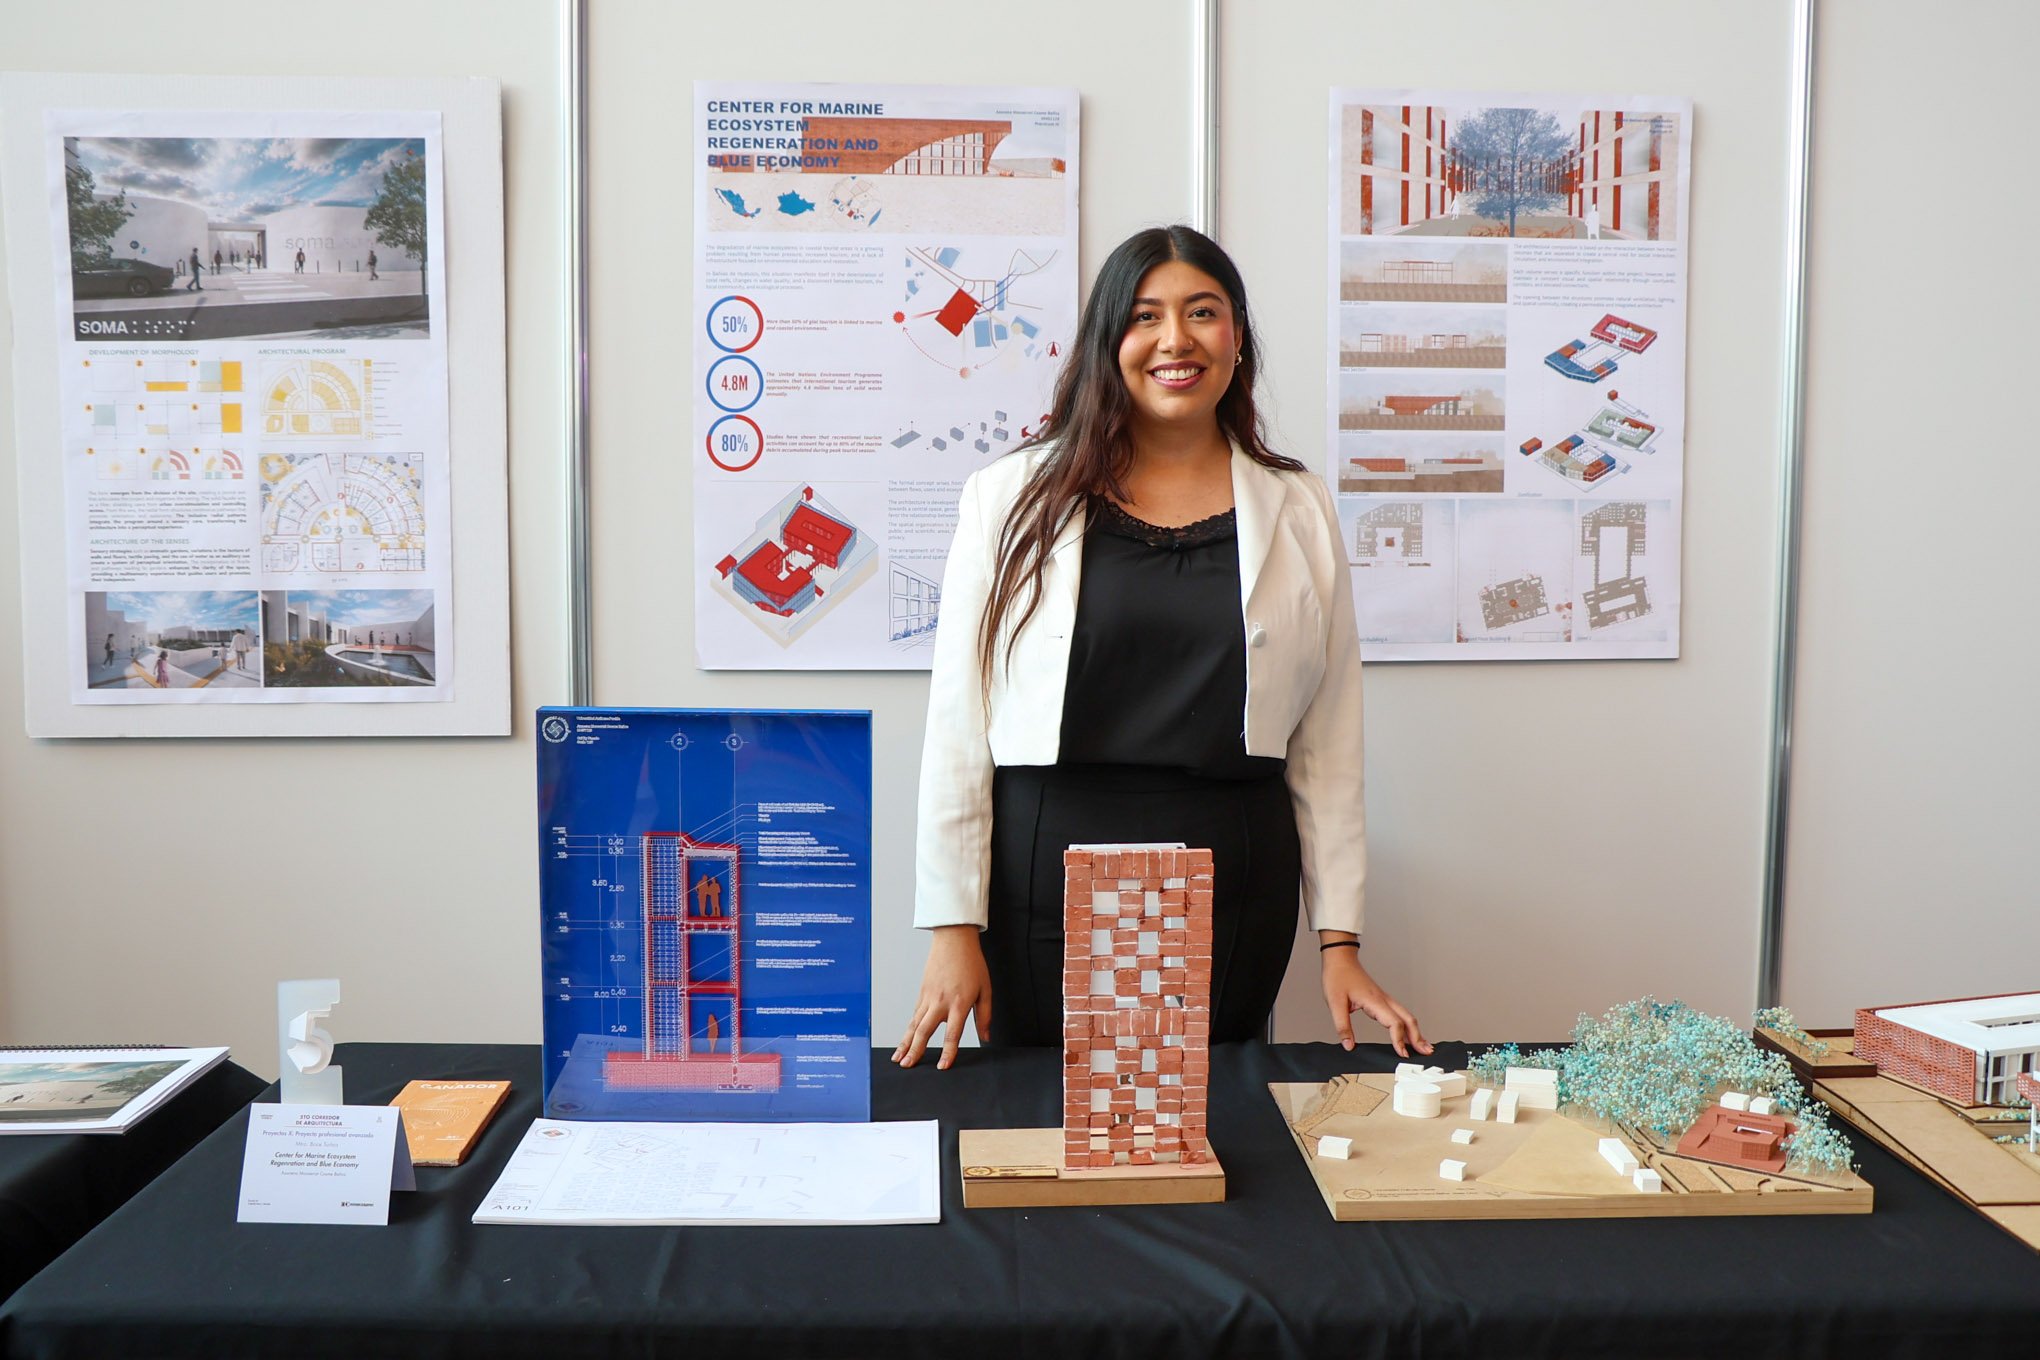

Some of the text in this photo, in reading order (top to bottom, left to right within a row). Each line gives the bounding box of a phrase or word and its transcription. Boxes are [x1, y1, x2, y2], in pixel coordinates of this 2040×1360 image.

[708, 101, 884, 115] CENTER FOR MARINE
[708, 119, 809, 131] ECOSYSTEM
[708, 137, 878, 150] REGENERATION AND
[708, 154, 840, 167] BLUE ECONOMY
[286, 237, 334, 249] soma
[80, 321, 129, 334] SOMA
[722, 316, 748, 333] 50%
[721, 375, 748, 391] 4.8M
[722, 434, 748, 452] 80%
[676, 737, 683, 745] 2
